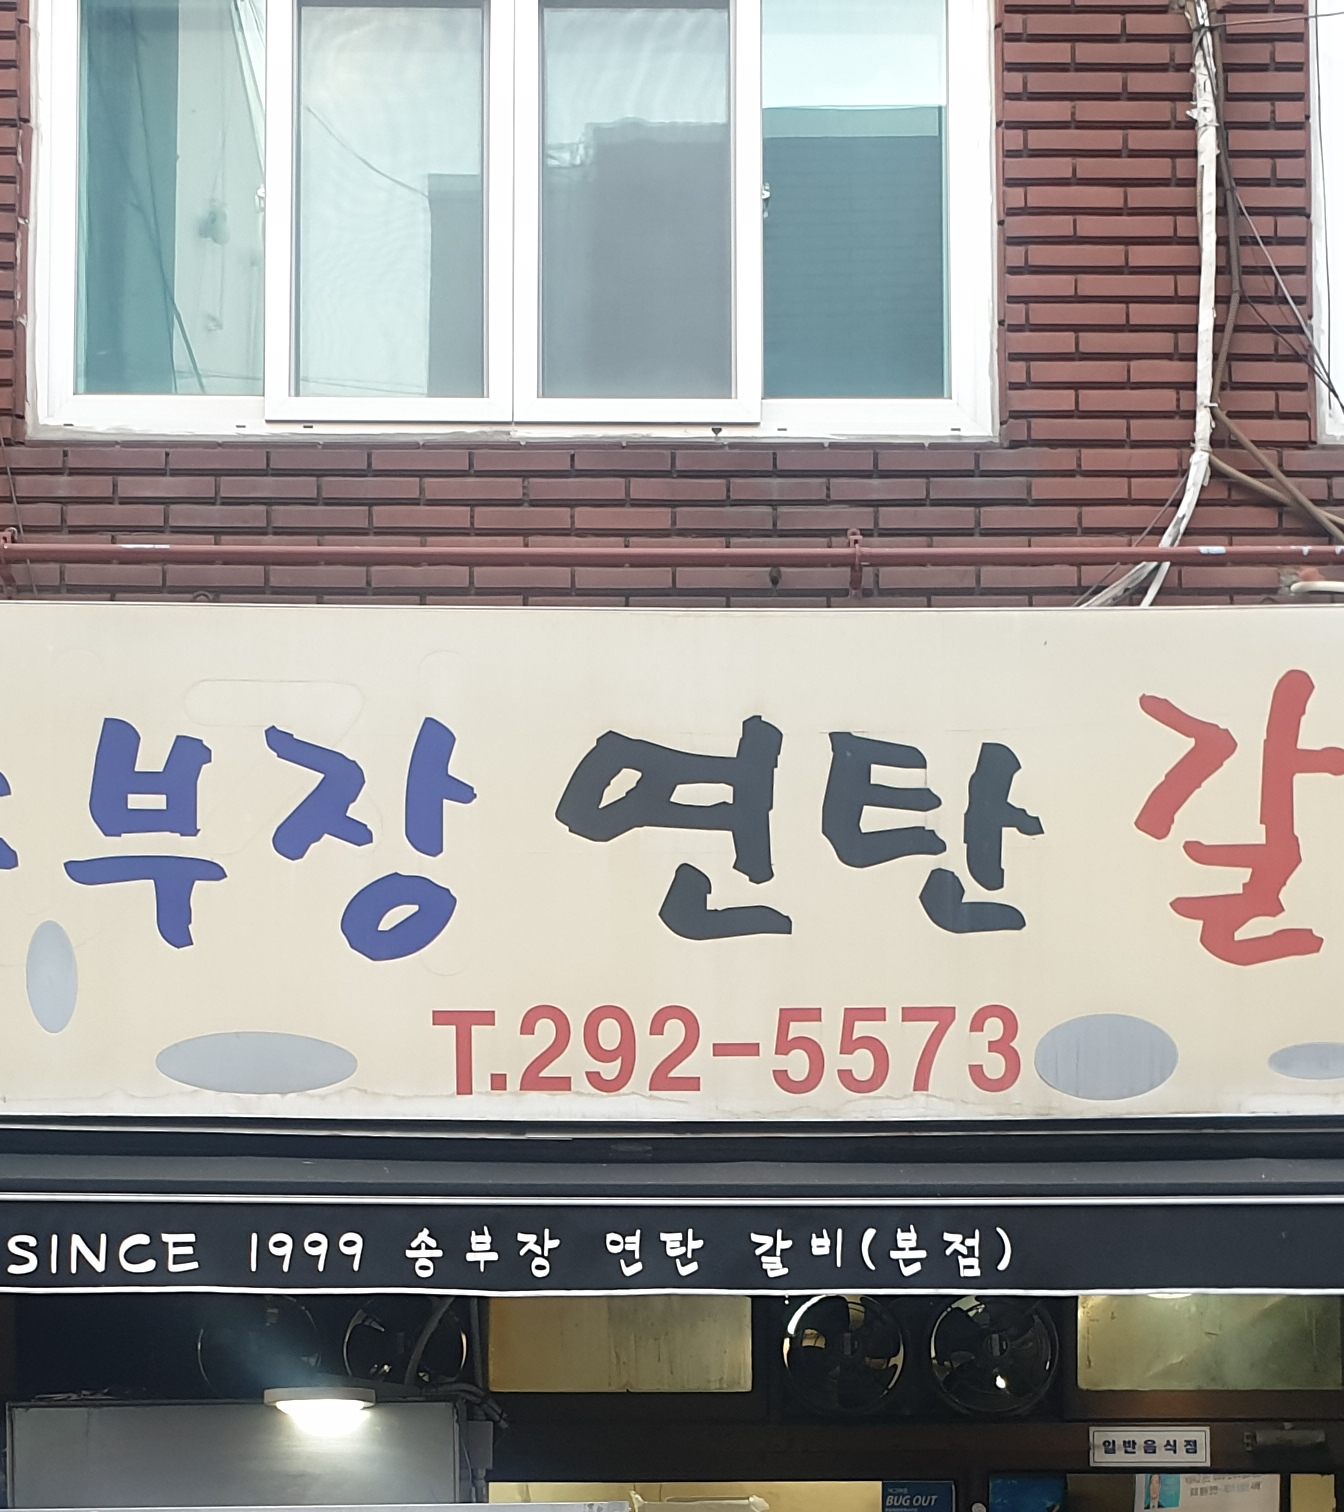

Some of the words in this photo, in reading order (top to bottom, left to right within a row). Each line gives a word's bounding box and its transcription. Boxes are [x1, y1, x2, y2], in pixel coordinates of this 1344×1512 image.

[555, 714, 1044, 940] 연탄
[432, 1004, 1022, 1096] T.292-5573
[6, 1232, 199, 1275] SINCE
[250, 1232, 364, 1273] 1999
[405, 1225, 561, 1278] 송부장
[605, 1227, 704, 1277] 연탄
[1102, 1440, 1197, 1454] 일반음식점
[886, 1495, 910, 1507] BUG
[913, 1495, 938, 1507] OUT
